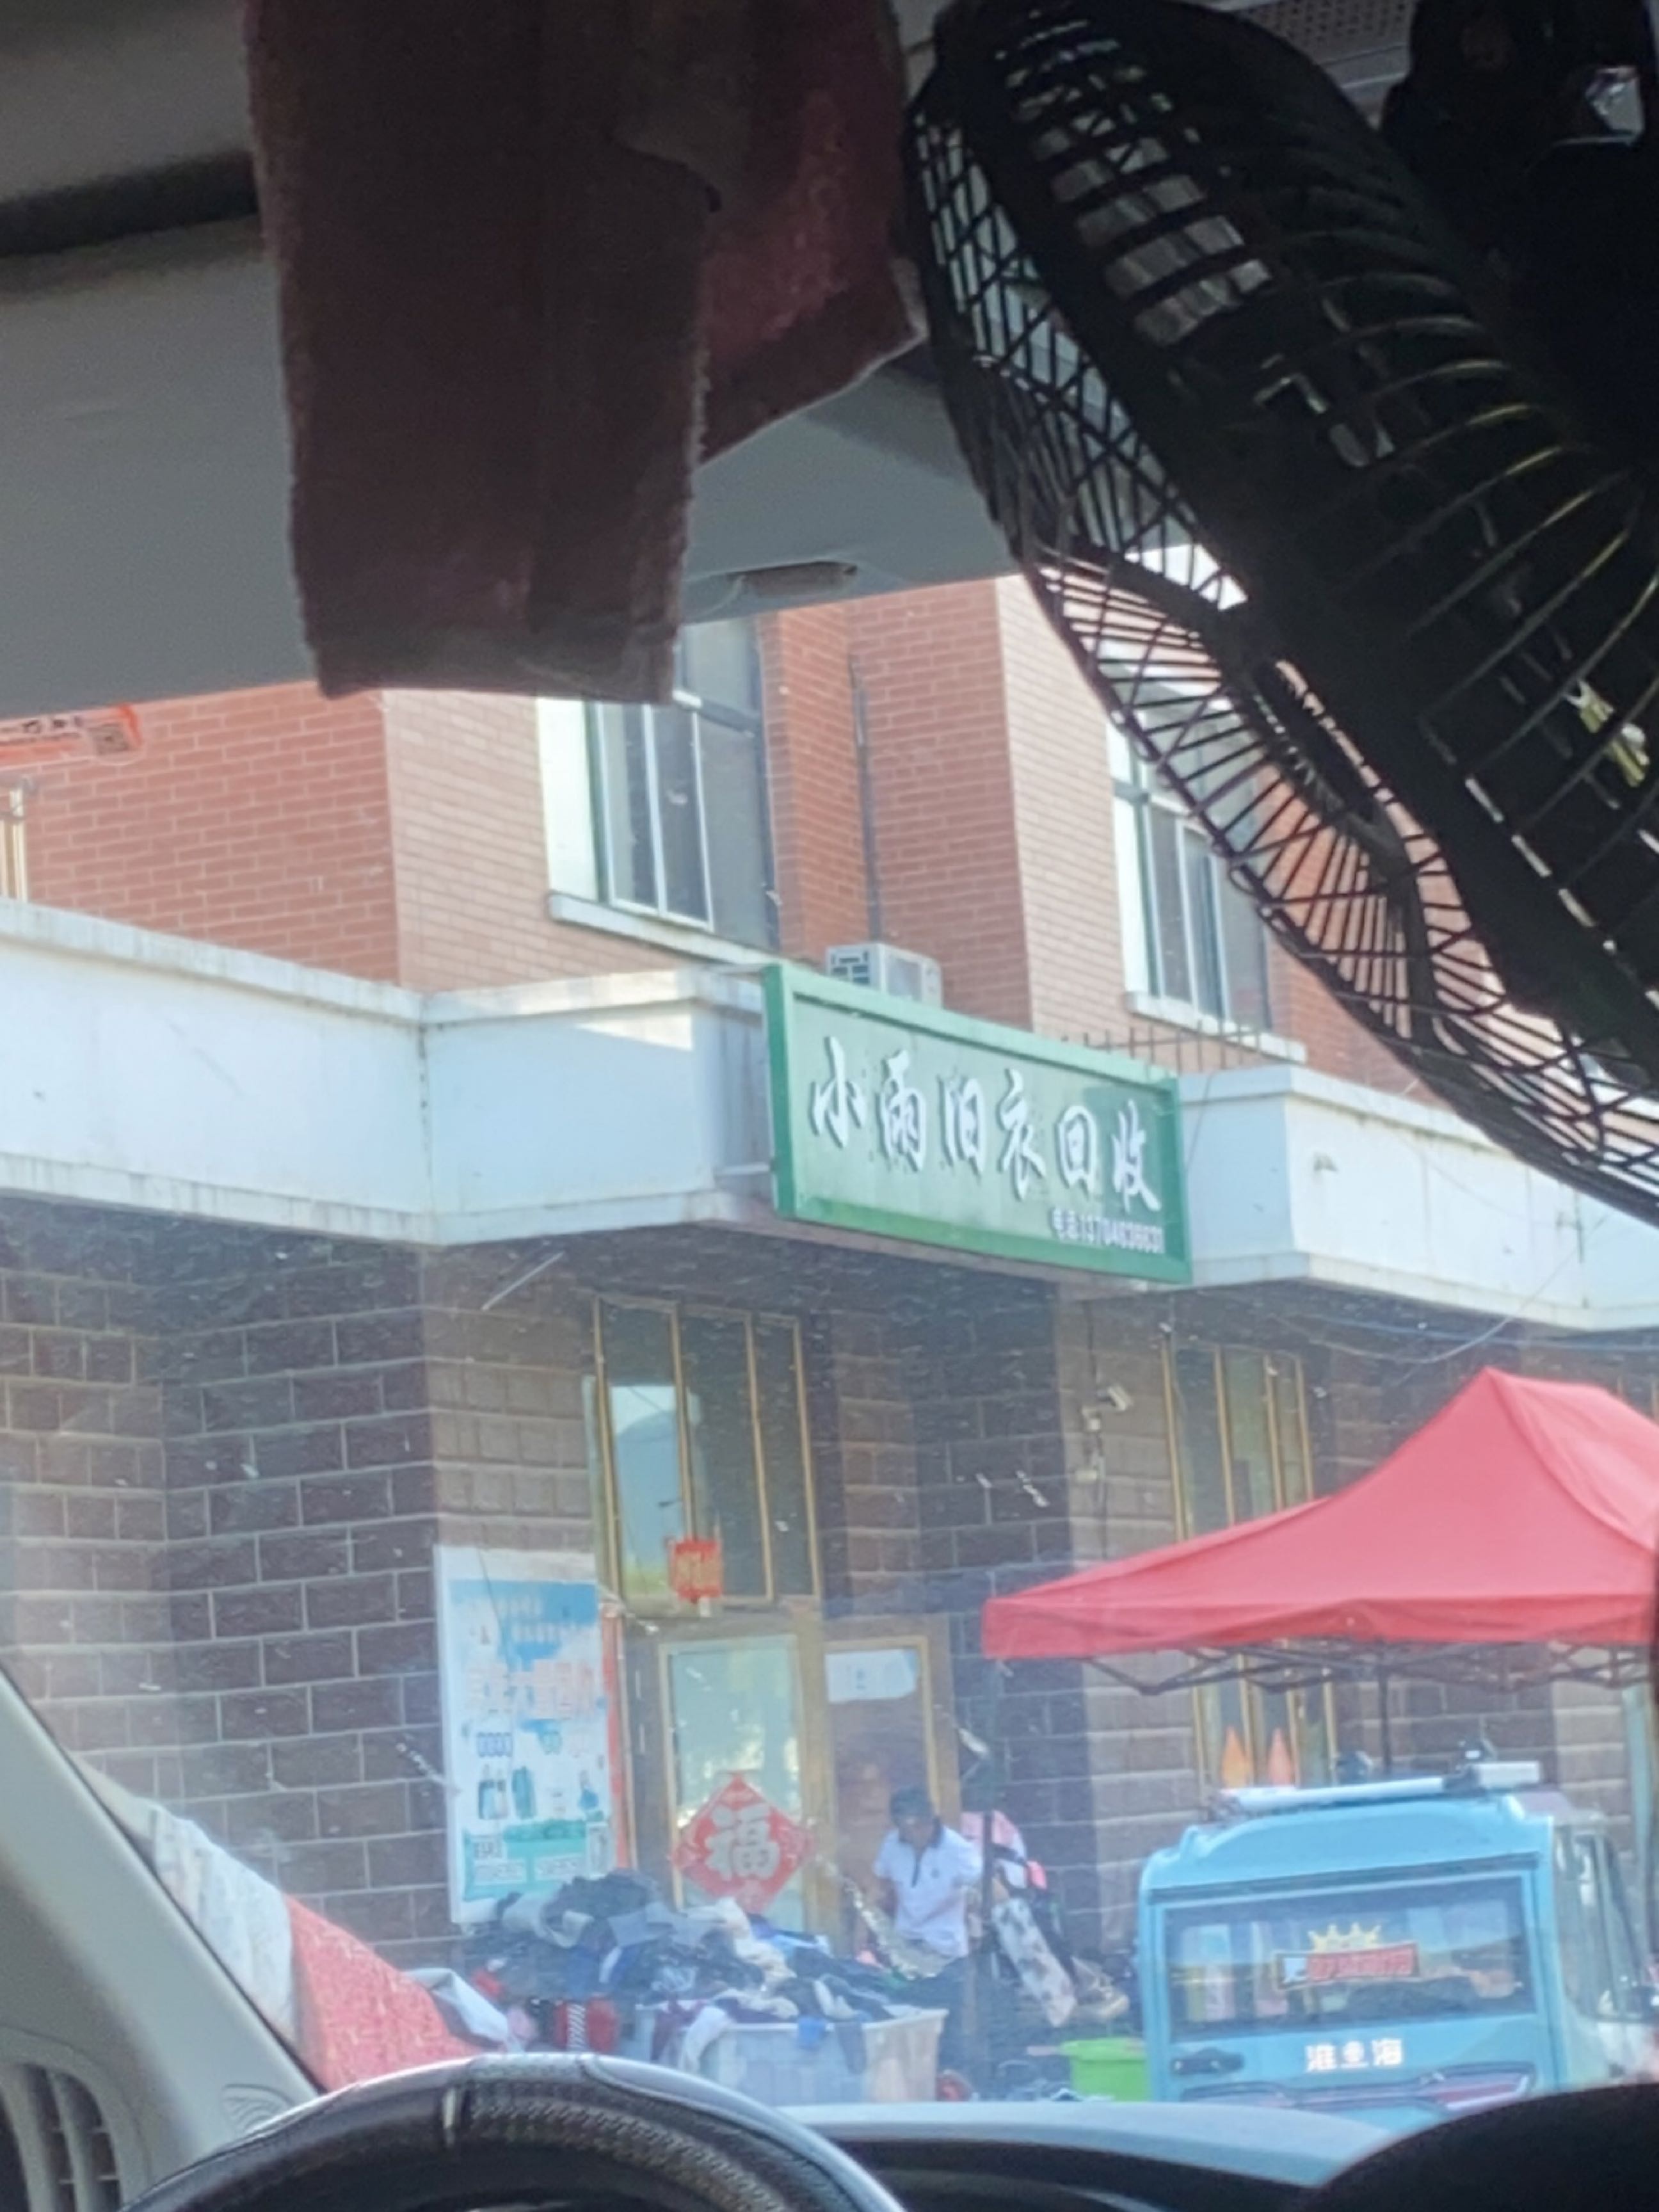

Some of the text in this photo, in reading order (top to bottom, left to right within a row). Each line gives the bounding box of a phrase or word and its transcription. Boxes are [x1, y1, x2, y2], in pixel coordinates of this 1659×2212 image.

[810, 1036, 1162, 1212] 小雨旧衣回收
[705, 1802, 780, 1881] 福
